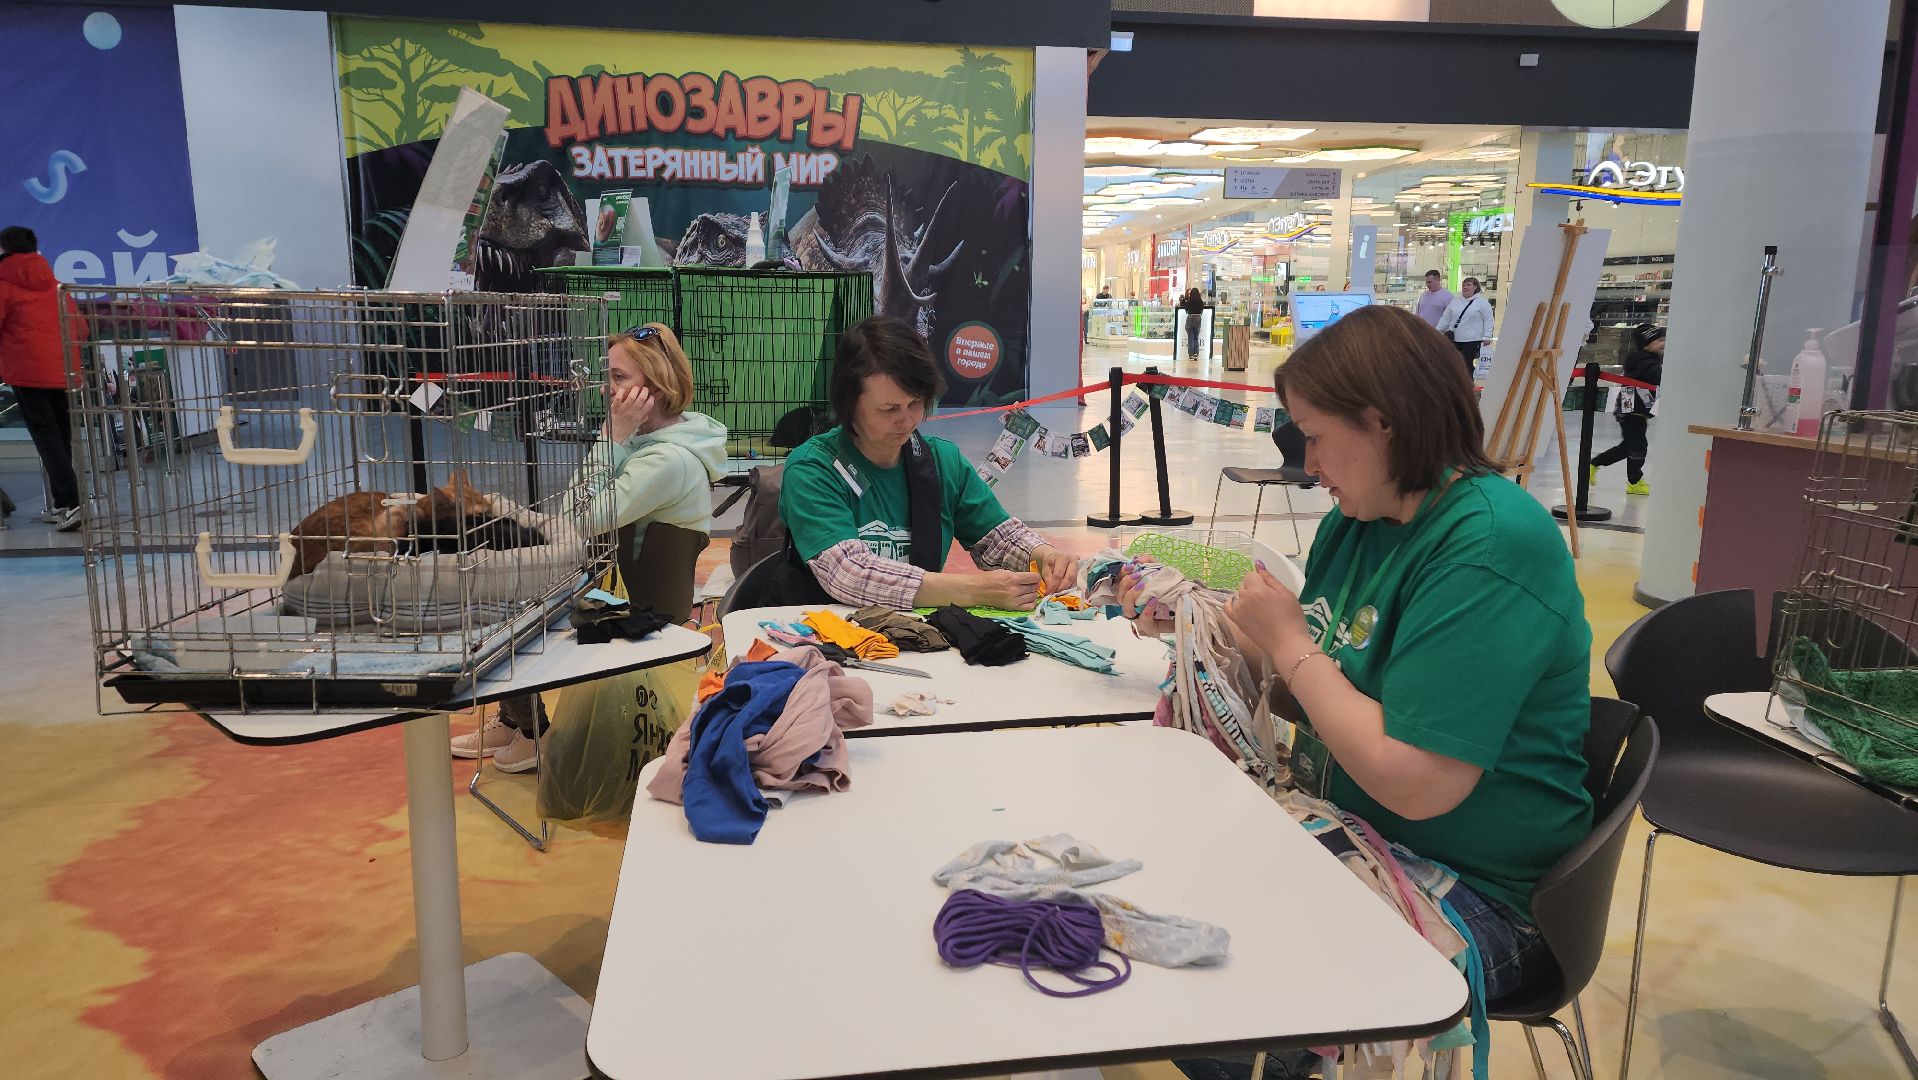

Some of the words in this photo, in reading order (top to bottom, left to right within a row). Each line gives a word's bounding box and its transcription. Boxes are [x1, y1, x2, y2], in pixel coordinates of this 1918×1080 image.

[545, 72, 862, 150] ДИНОЗАВРЫ
[571, 144, 765, 182] ЗАТЕРЯННЫЙ
[774, 151, 839, 186] МИР
[956, 336, 995, 350] Впервые
[957, 358, 987, 370] городе
